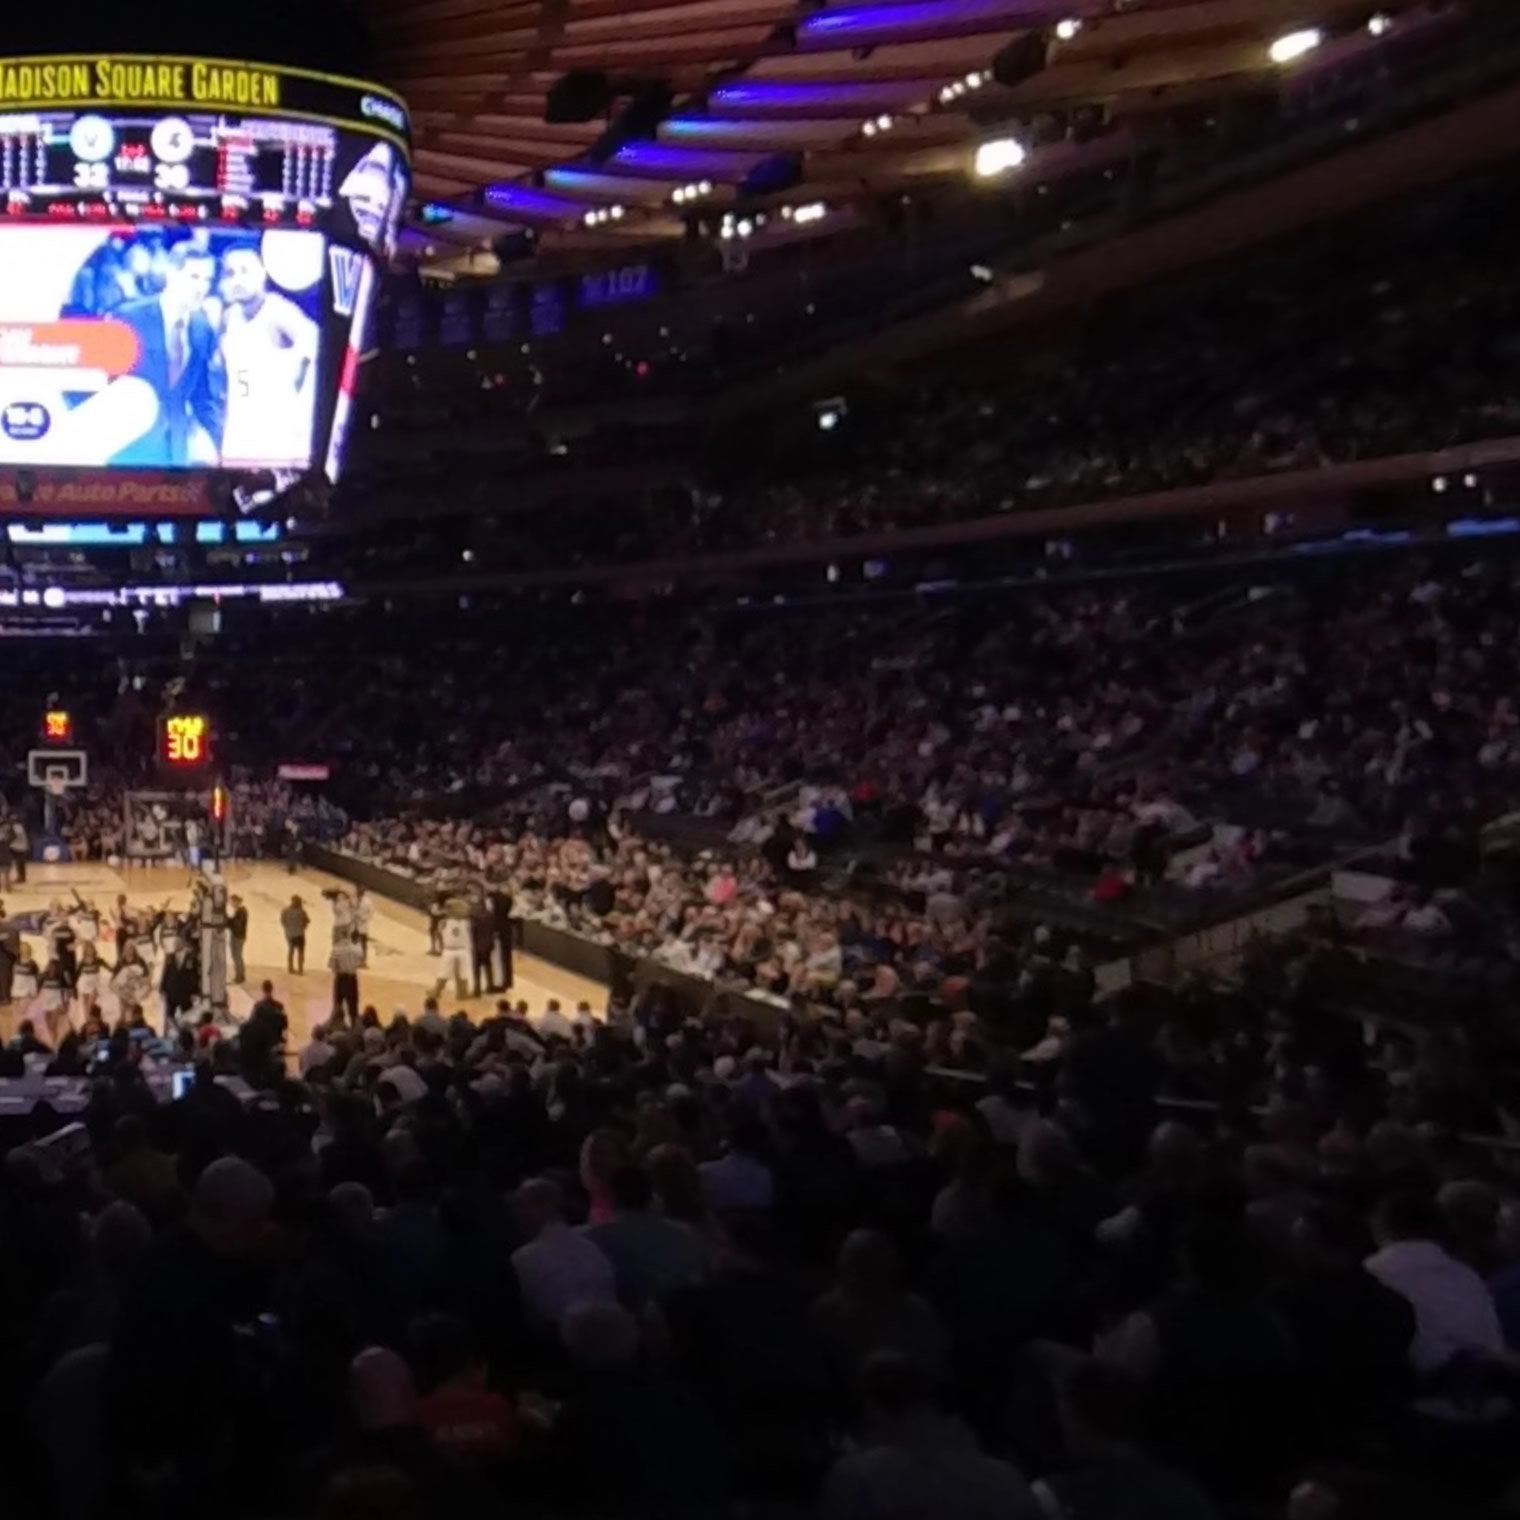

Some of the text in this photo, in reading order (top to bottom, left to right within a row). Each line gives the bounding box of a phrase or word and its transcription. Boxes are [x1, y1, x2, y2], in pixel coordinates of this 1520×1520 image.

[95, 59, 184, 100] SQUARE
[191, 62, 278, 105] GARDEN
[57, 482, 116, 501] Auto
[118, 481, 184, 502] Parts
[168, 734, 199, 759] 30
